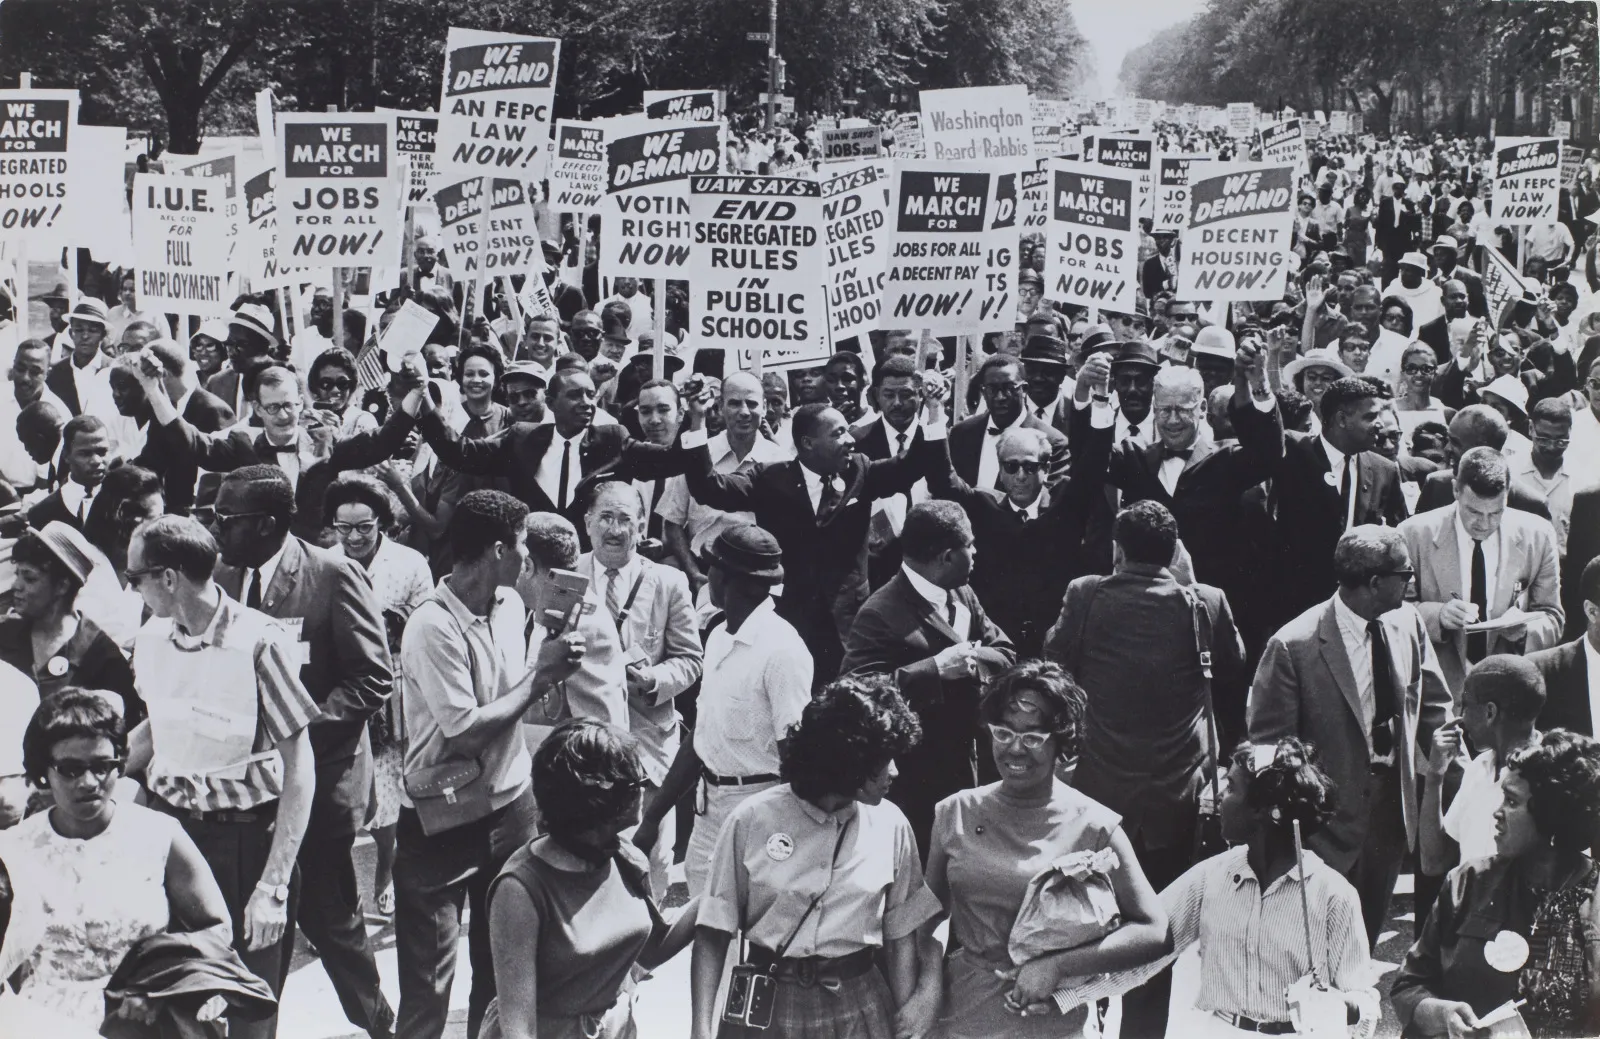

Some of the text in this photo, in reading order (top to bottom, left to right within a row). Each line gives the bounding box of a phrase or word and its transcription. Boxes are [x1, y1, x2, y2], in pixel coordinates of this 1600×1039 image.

[484, 44, 523, 66] WE
[453, 62, 550, 91] DEMAND
[6, 103, 36, 118] WE
[451, 98, 548, 122] AN FEPC
[656, 106, 713, 121] MAND
[667, 96, 693, 113] WE
[400, 119, 421, 130] WE
[929, 107, 1024, 134] Washington
[1273, 123, 1288, 135] WE
[320, 126, 352, 142] WE
[470, 122, 527, 142] LAW
[581, 129, 600, 140] WE
[826, 130, 875, 141] UAW SAYS
[1265, 127, 1300, 148] DEMAND
[4, 141, 36, 150] FOR
[292, 144, 380, 163] MARCH
[642, 131, 685, 158] WE
[824, 142, 861, 158] JOBS
[982, 136, 1029, 159] Rabbis
[1117, 141, 1134, 150] WE
[1282, 144, 1303, 153] FEPC
[1516, 143, 1540, 159] WE
[452, 142, 538, 168] NOW!
[577, 151, 599, 160] FOR
[1101, 149, 1148, 162] MARCH
[1276, 154, 1297, 163] LAW
[1499, 152, 1557, 176] DEMAND
[191, 163, 213, 177] WE
[319, 165, 355, 176] FOR
[554, 170, 579, 180] CIVIL
[613, 149, 717, 187] DEMAND
[462, 179, 483, 198] W
[569, 181, 599, 191] LAWS
[695, 177, 819, 196] UAW SAYS:
[933, 176, 960, 193] WE
[1080, 177, 1105, 194] WE
[1222, 171, 1262, 195] WE
[1499, 179, 1519, 189] AN
[1524, 178, 1556, 189] FEPC
[147, 185, 215, 213] I.U.E.
[292, 187, 380, 210] JOBS
[444, 186, 521, 222] DEMND
[557, 191, 602, 206] NOW
[1022, 190, 1041, 201] AN
[1058, 190, 1126, 217] MARCH
[1511, 192, 1545, 202] LAW
[712, 200, 797, 222] END
[904, 196, 982, 216] MARCH
[1194, 187, 1290, 224] DEMAND
[1501, 203, 1552, 218] NOW!
[295, 215, 377, 225] FOR ALL
[456, 218, 523, 236] DEENT
[825, 209, 885, 246] EGATED
[927, 218, 957, 229] FOR
[1078, 213, 1105, 225] FOR
[168, 225, 194, 237] FOR
[694, 222, 818, 247] SEGREGATED
[1201, 228, 1279, 244] DECENT
[292, 229, 384, 256] NOW!
[892, 241, 982, 258] JOBS FOR ALL
[1058, 231, 1124, 261] JOBS
[166, 240, 193, 267] FULL
[465, 247, 533, 272] NOW!
[618, 242, 691, 267] NOW
[711, 248, 798, 271] RULES
[1190, 251, 1284, 266] HOUSING
[888, 265, 980, 282] A DECENT PAY
[1059, 256, 1121, 274] FOR ALL
[737, 277, 770, 289] IN
[835, 267, 857, 284] IN
[1194, 267, 1278, 290] NOW!
[142, 270, 221, 302] EMPLOYMENT
[1055, 273, 1126, 302] NOW!
[706, 290, 806, 314] PUBLIC
[893, 288, 973, 318] NOW!
[701, 315, 809, 342] SCHOOLS
